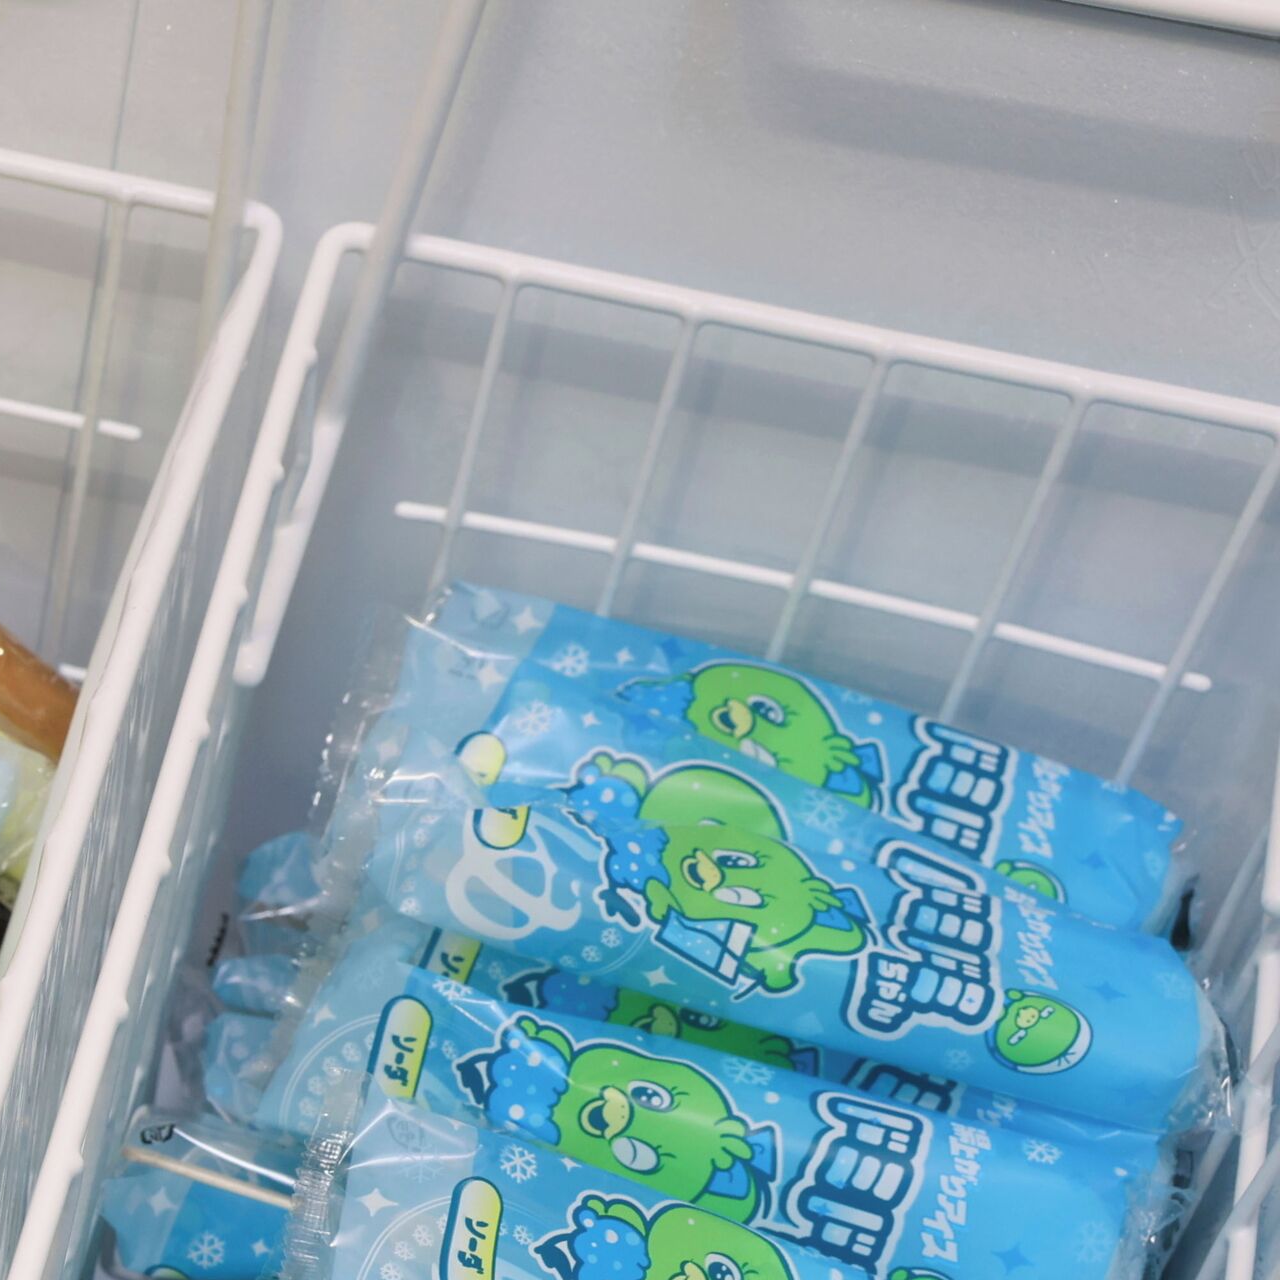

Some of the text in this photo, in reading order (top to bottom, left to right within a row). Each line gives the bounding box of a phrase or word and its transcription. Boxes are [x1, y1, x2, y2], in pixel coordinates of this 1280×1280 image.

[866, 960, 911, 1024] ちゃん
[383, 1034, 418, 1088] ソーダ
[920, 1120, 993, 1263] 湯上がりアイス
[457, 1216, 490, 1275] ソーダ
